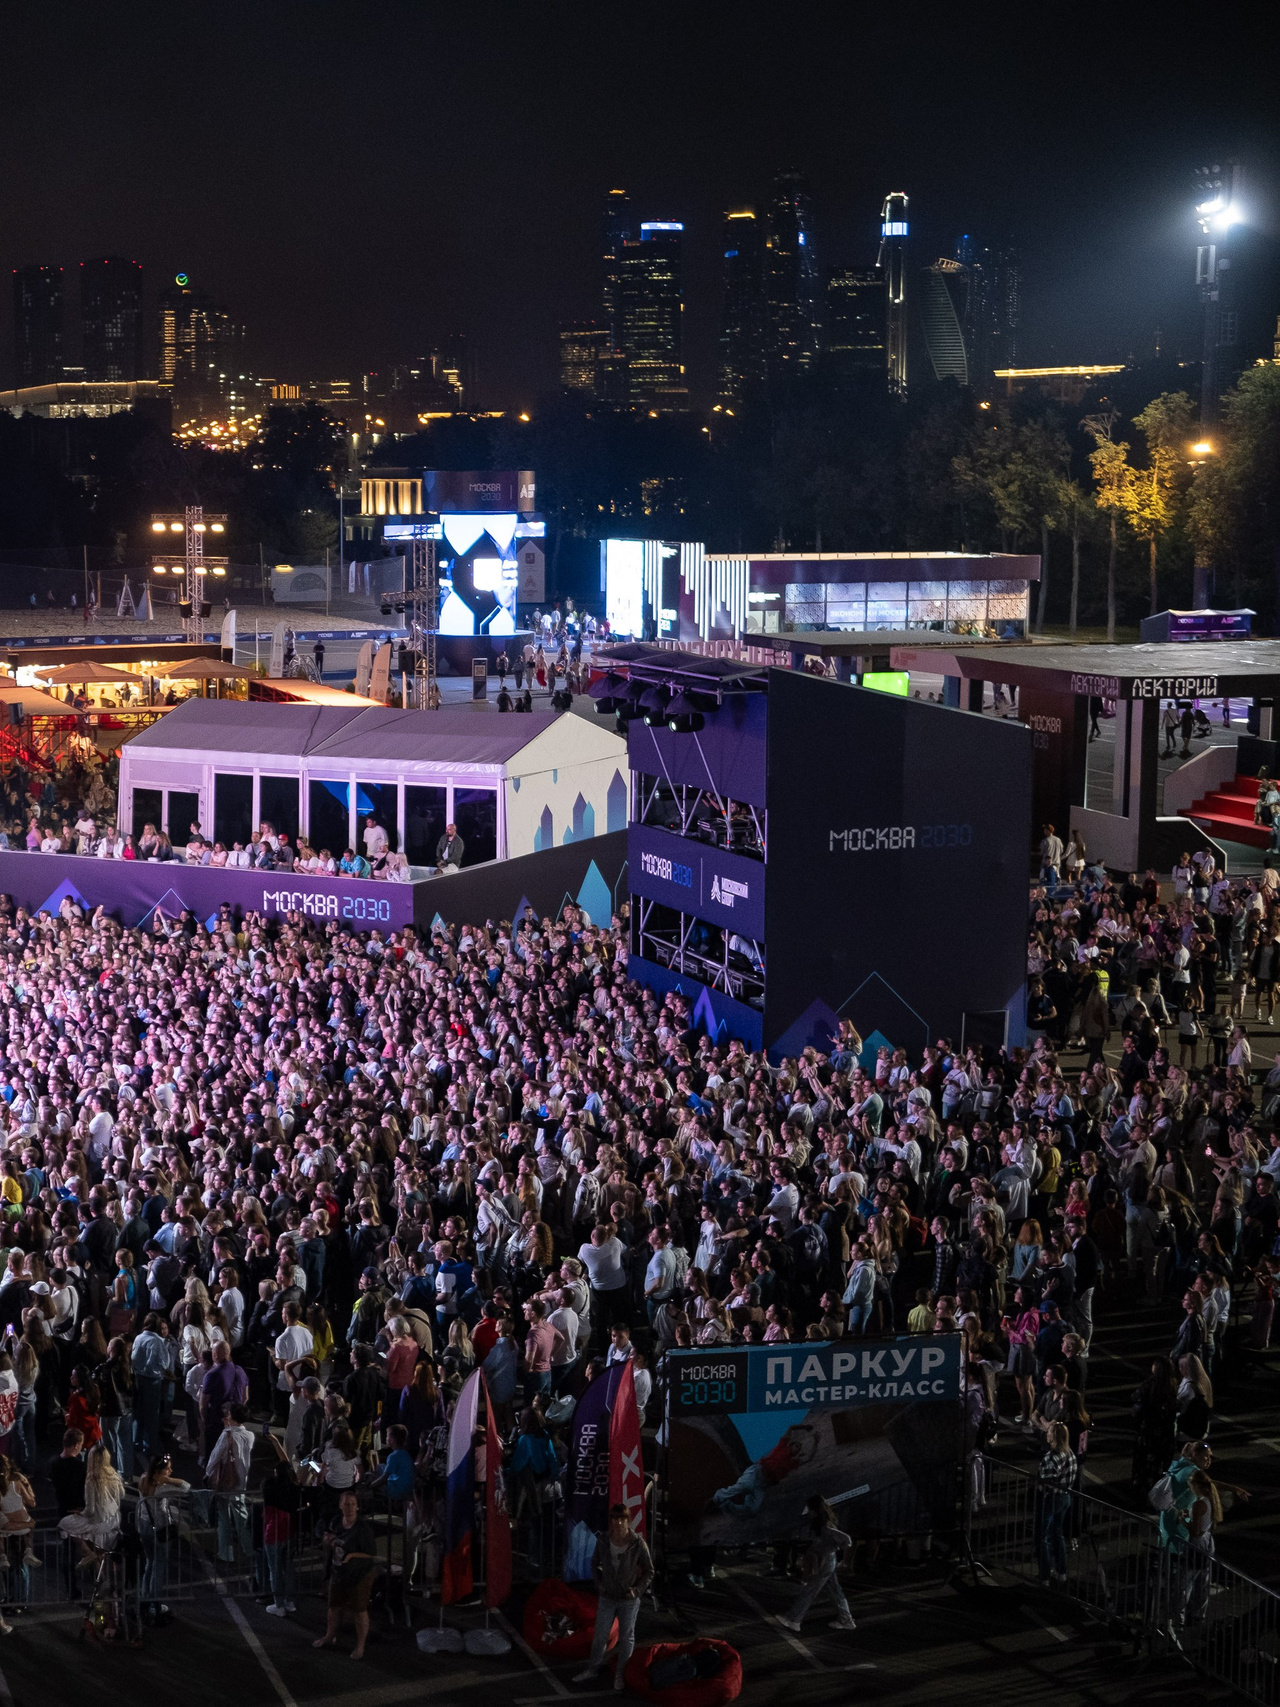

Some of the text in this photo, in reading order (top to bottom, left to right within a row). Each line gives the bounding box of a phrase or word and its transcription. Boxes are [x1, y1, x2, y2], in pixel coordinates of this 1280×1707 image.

[469, 483, 501, 492] МОСКВА
[1071, 674, 1119, 696] ЛЕКТОРИЙ
[1132, 676, 1218, 697] ЛЕКТОРИЙ
[1029, 715, 1062, 733] МОСКВА
[1032, 732, 1049, 749] 030
[829, 824, 972, 851] МОСКВА 2030
[641, 852, 693, 888] МОСКВА 2030
[263, 890, 390, 921] МОСКВА 2030
[681, 1364, 736, 1381] МОСКВА
[766, 1347, 946, 1385] ПАРКУР
[680, 1380, 737, 1405] 2030
[765, 1379, 946, 1406] МАСТЕР-КЛАСС
[573, 1424, 598, 1496] МОСКВА
